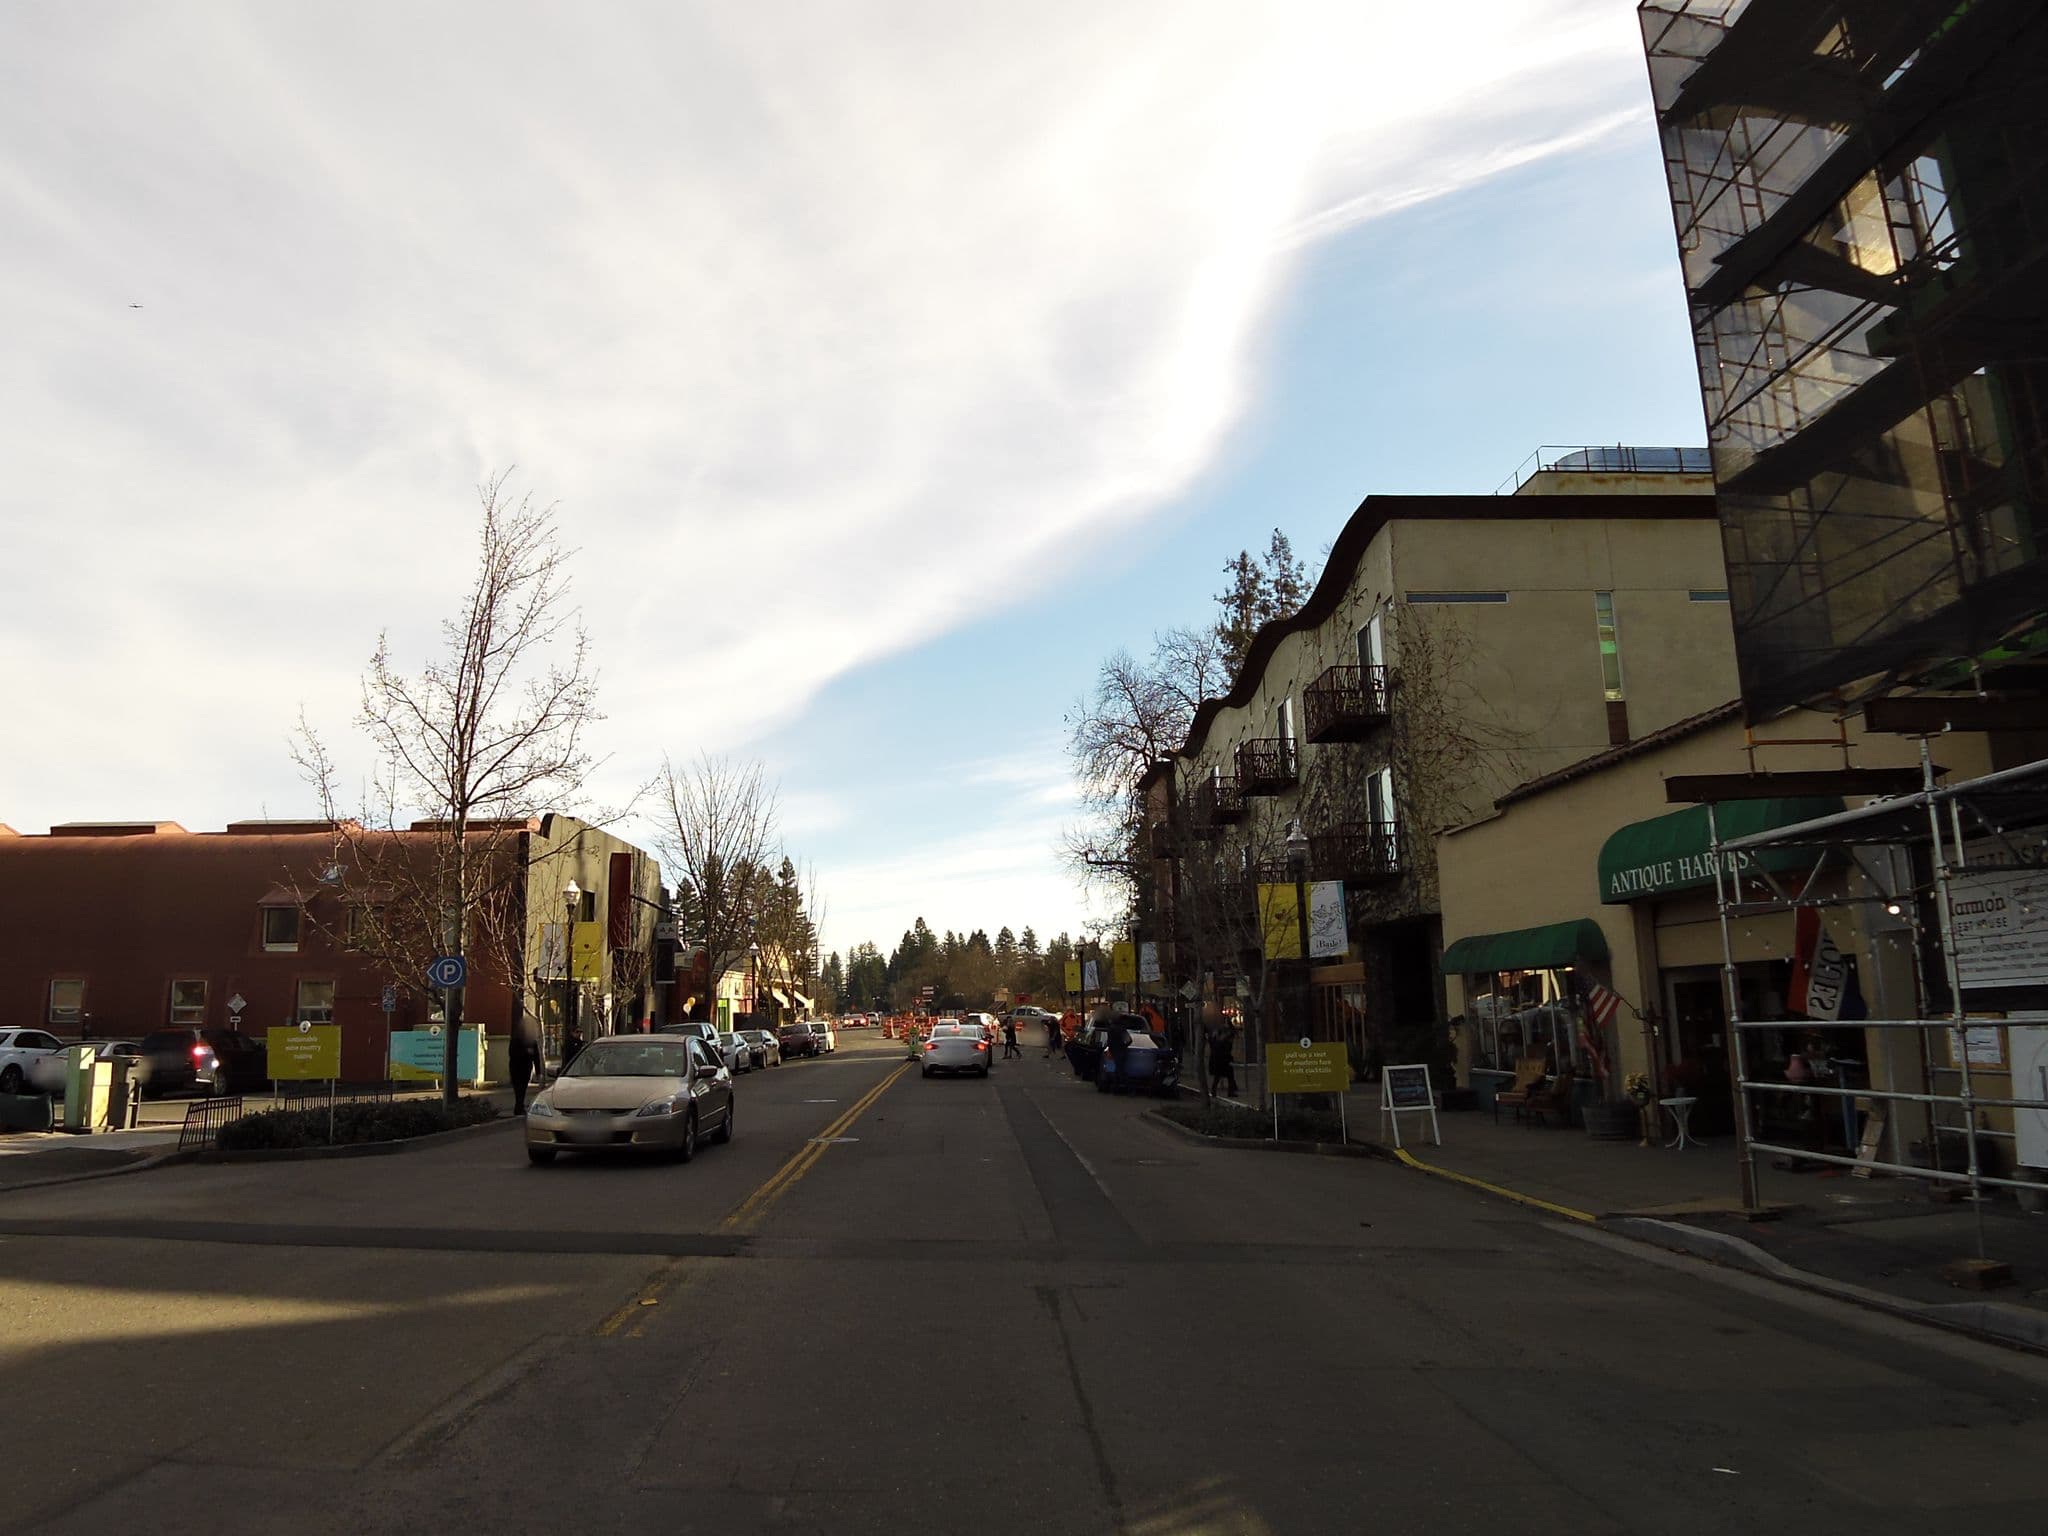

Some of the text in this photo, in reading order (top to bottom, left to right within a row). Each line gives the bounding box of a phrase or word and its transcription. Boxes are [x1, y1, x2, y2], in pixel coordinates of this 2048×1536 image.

[1611, 861, 1674, 894] ANTIQUE
[1949, 897, 2007, 917] armon
[443, 964, 456, 980] P
